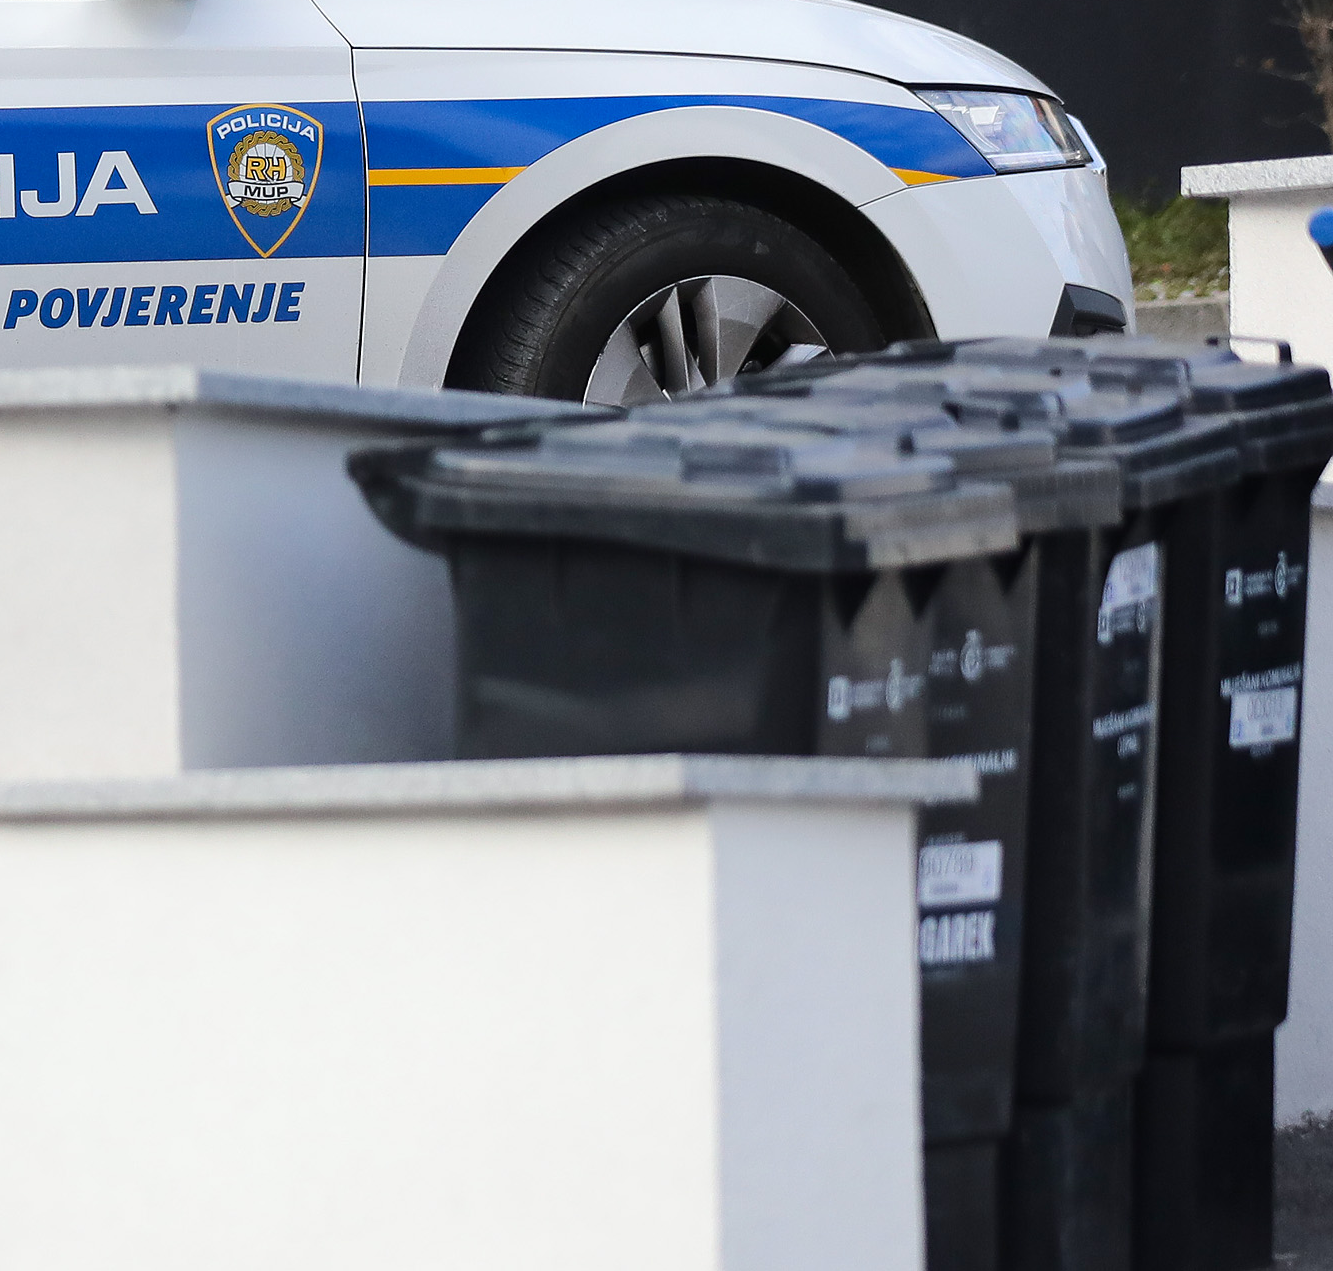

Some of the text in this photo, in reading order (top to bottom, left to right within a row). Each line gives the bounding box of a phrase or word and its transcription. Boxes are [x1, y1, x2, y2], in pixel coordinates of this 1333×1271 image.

[216, 113, 315, 142] POLICIJA
[246, 156, 287, 181] RH
[244, 185, 289, 197] MUP
[3, 281, 305, 330] POVJERENJE
